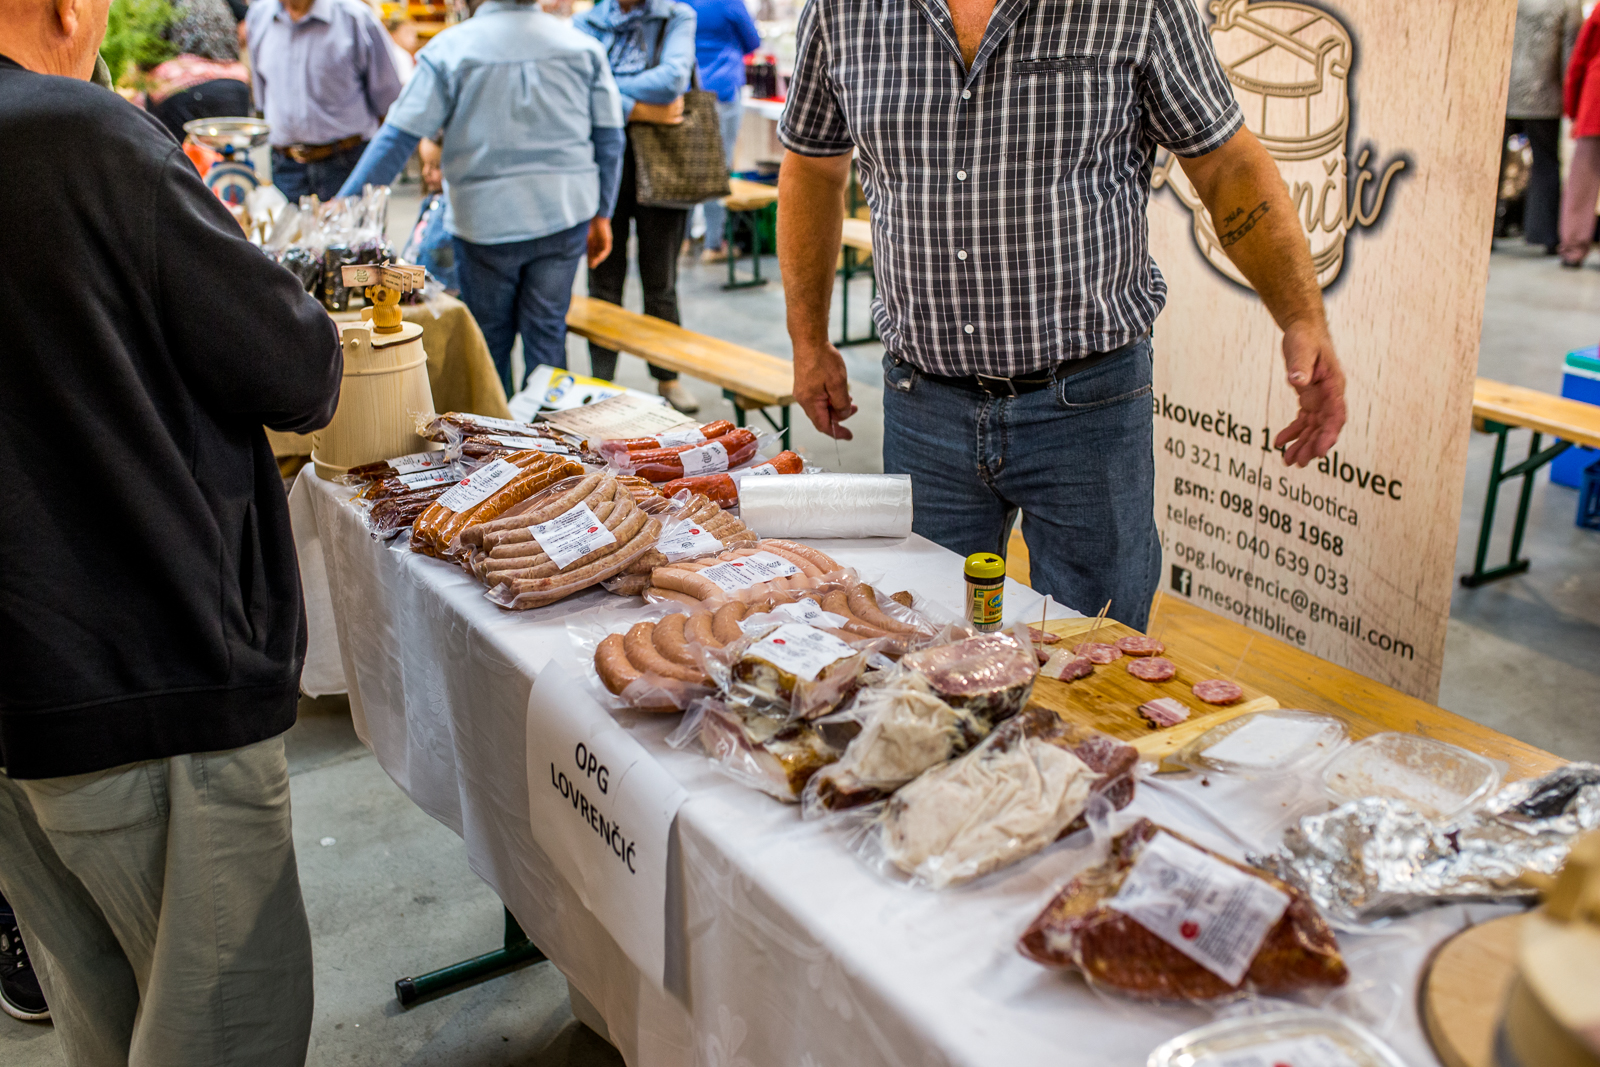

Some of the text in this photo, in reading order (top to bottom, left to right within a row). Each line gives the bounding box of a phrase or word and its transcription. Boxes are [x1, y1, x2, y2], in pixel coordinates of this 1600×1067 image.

[1153, 393, 1252, 445] akovečka
[1318, 451, 1403, 500] alovec
[1164, 437, 1358, 526] 40 321 Mala Subotica
[1167, 503, 1231, 544] telefon:
[1236, 530, 1270, 560] 040
[1275, 546, 1310, 577] 639
[1314, 563, 1349, 596] 033
[1174, 477, 1344, 557] gsm: 098 908 1968
[1174, 541, 1415, 661] opg.lovrencic@gmail.com
[1198, 584, 1307, 646] mesoztiblice
[574, 742, 610, 795] OPG
[550, 762, 636, 875] LOVRENČIĆ
